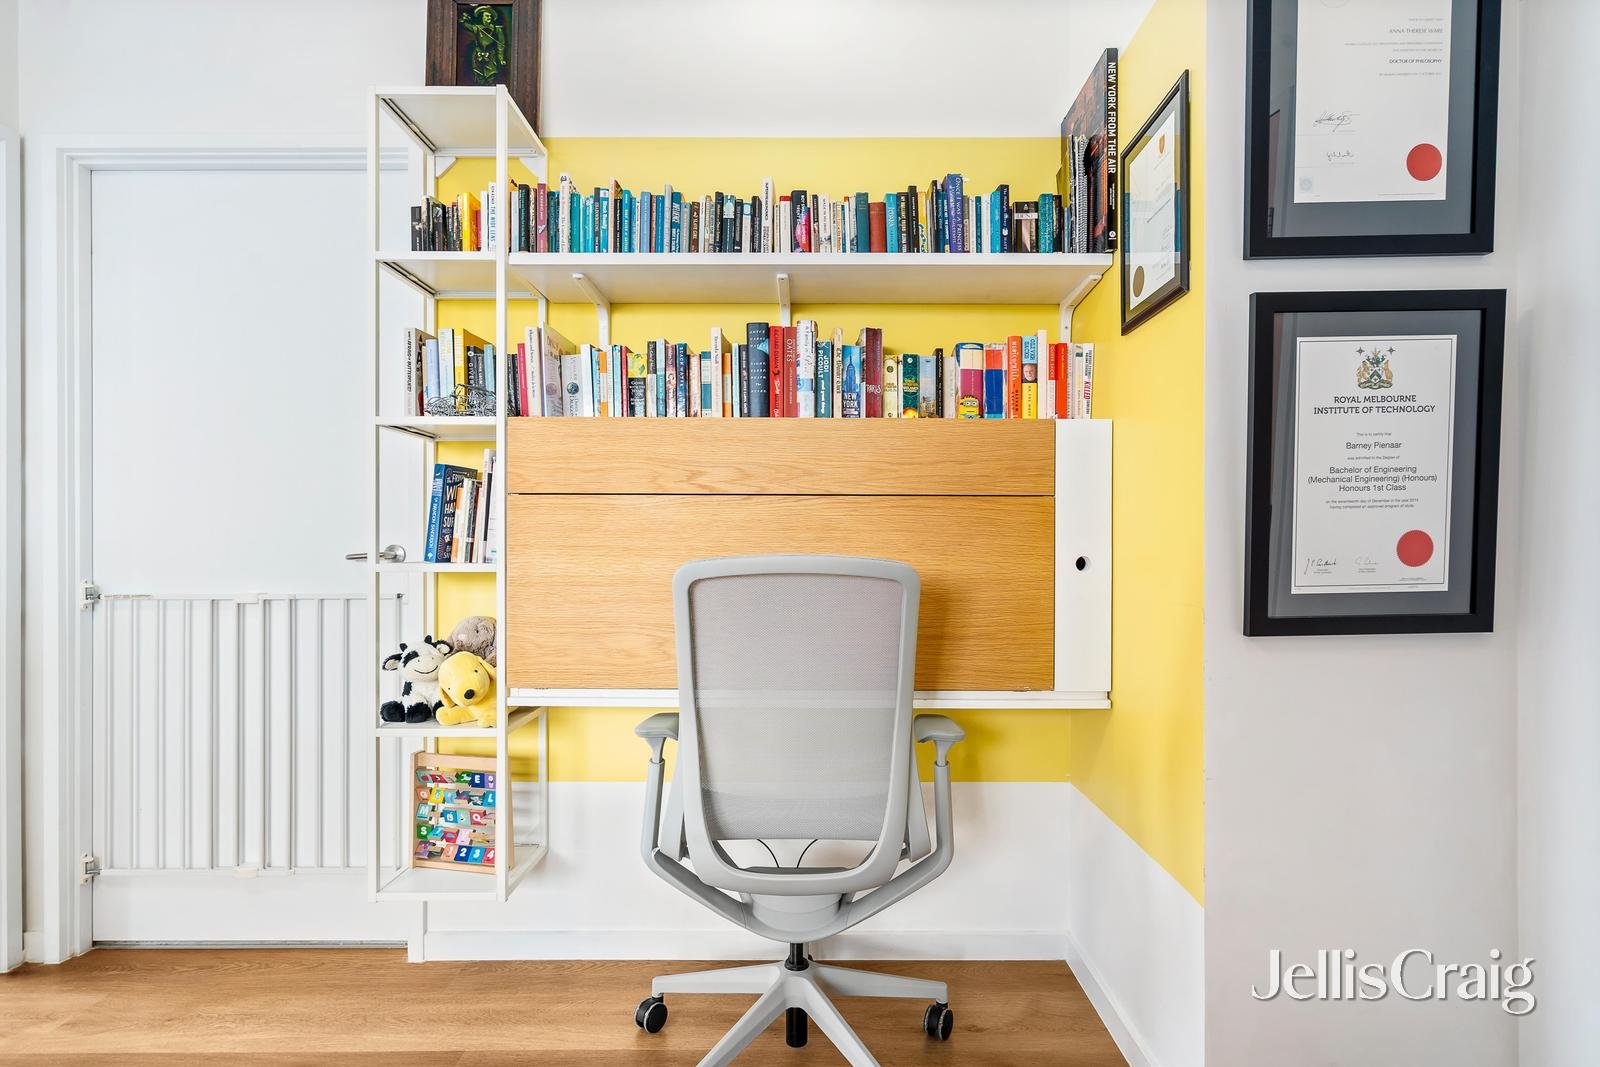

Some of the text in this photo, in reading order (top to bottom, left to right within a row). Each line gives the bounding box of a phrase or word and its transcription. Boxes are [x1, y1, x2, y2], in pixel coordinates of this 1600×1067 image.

[1107, 62, 1116, 83] NEW
[1107, 85, 1116, 109] YORK
[1107, 111, 1116, 137] FROM
[1107, 140, 1116, 156] THE
[1107, 158, 1116, 173] AIR
[866, 384, 881, 395] PARIS
[1083, 381, 1091, 400] KILLED
[843, 392, 858, 400] NEW
[1333, 395, 1417, 404] ROYAL MELBOURNE
[843, 400, 858, 408] YORK
[1313, 405, 1436, 415] INSTITUTE OF TECHNOLOGY
[1345, 441, 1402, 451] Barney Pienaar
[1329, 466, 1362, 474] Bachelor
[1373, 465, 1417, 475] Engineering
[1307, 474, 1438, 484] (Mechanical Engineering) (Honours)
[1339, 484, 1371, 492] Honours
[1373, 484, 1384, 492] 1st
[429, 524, 437, 548] SANDERSON
[474, 774, 481, 784] E
[420, 826, 427, 835] S
[459, 848, 467, 857] 2
[473, 849, 481, 858] 3
[487, 850, 495, 859] 4
